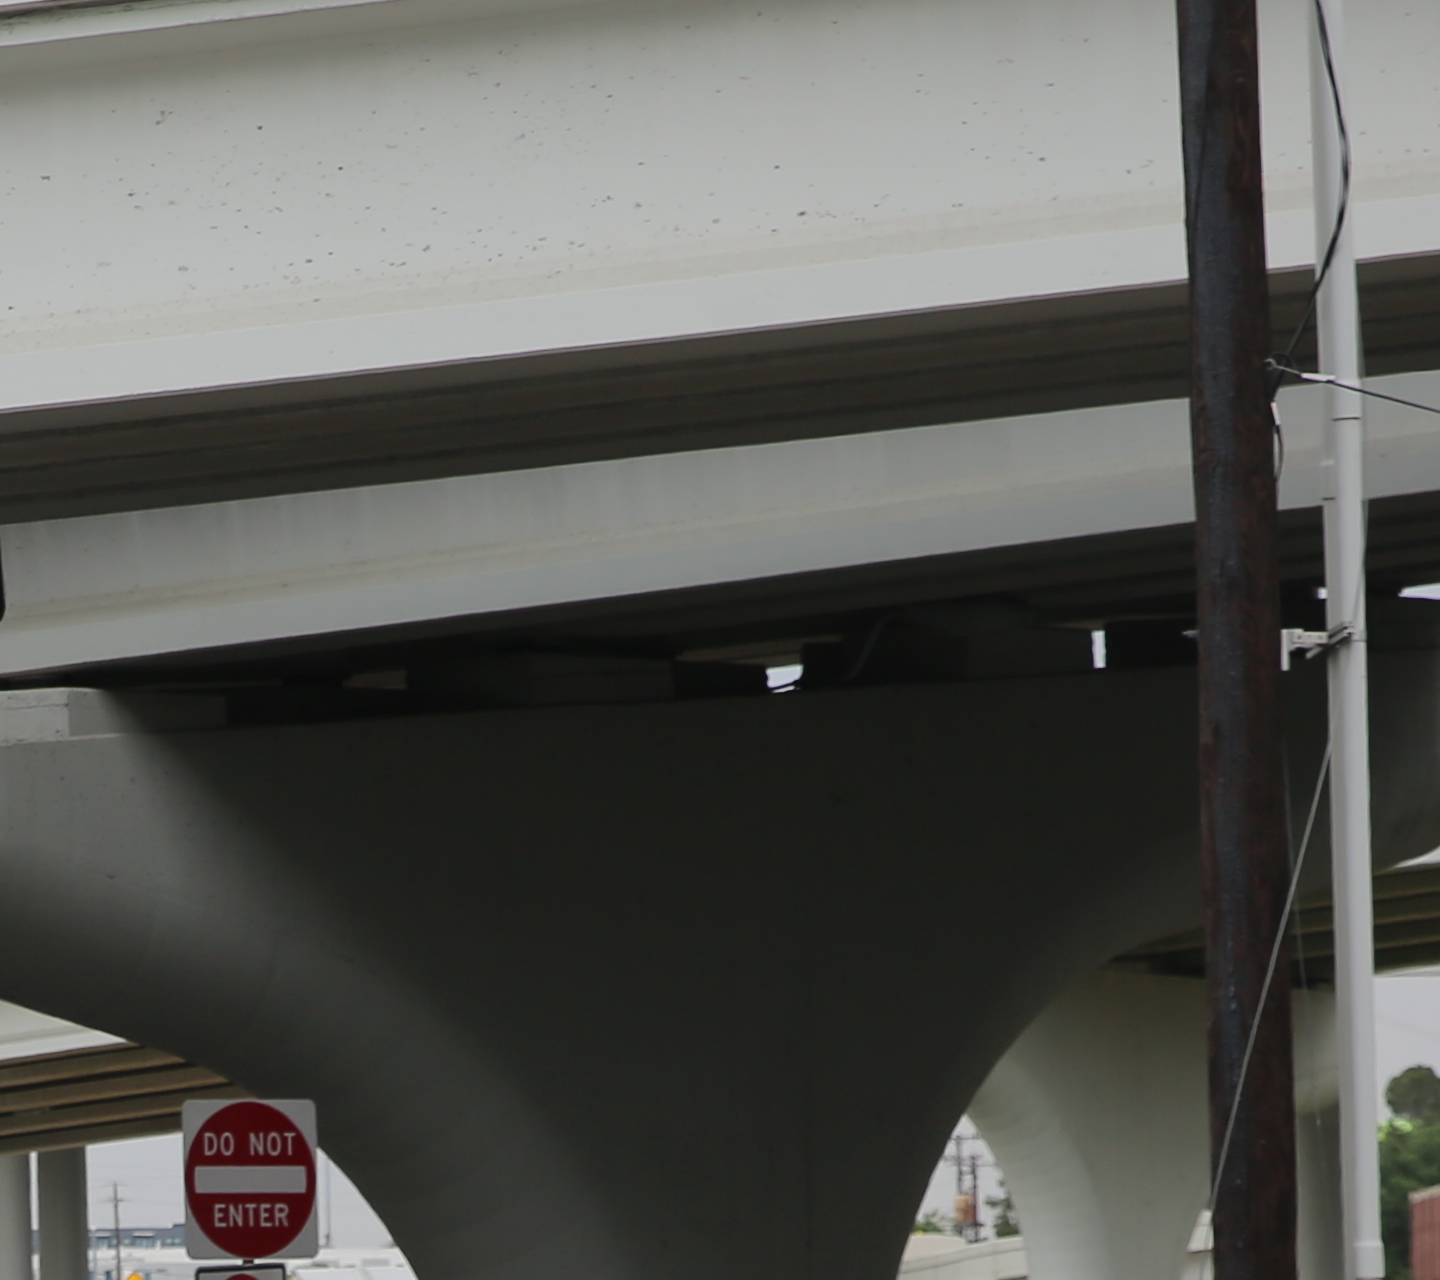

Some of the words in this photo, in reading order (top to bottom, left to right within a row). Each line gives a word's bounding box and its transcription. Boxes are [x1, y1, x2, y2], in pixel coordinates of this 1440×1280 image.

[203, 1132, 235, 1157] DO
[249, 1132, 296, 1157] NOT
[213, 1204, 290, 1228] ENTER
